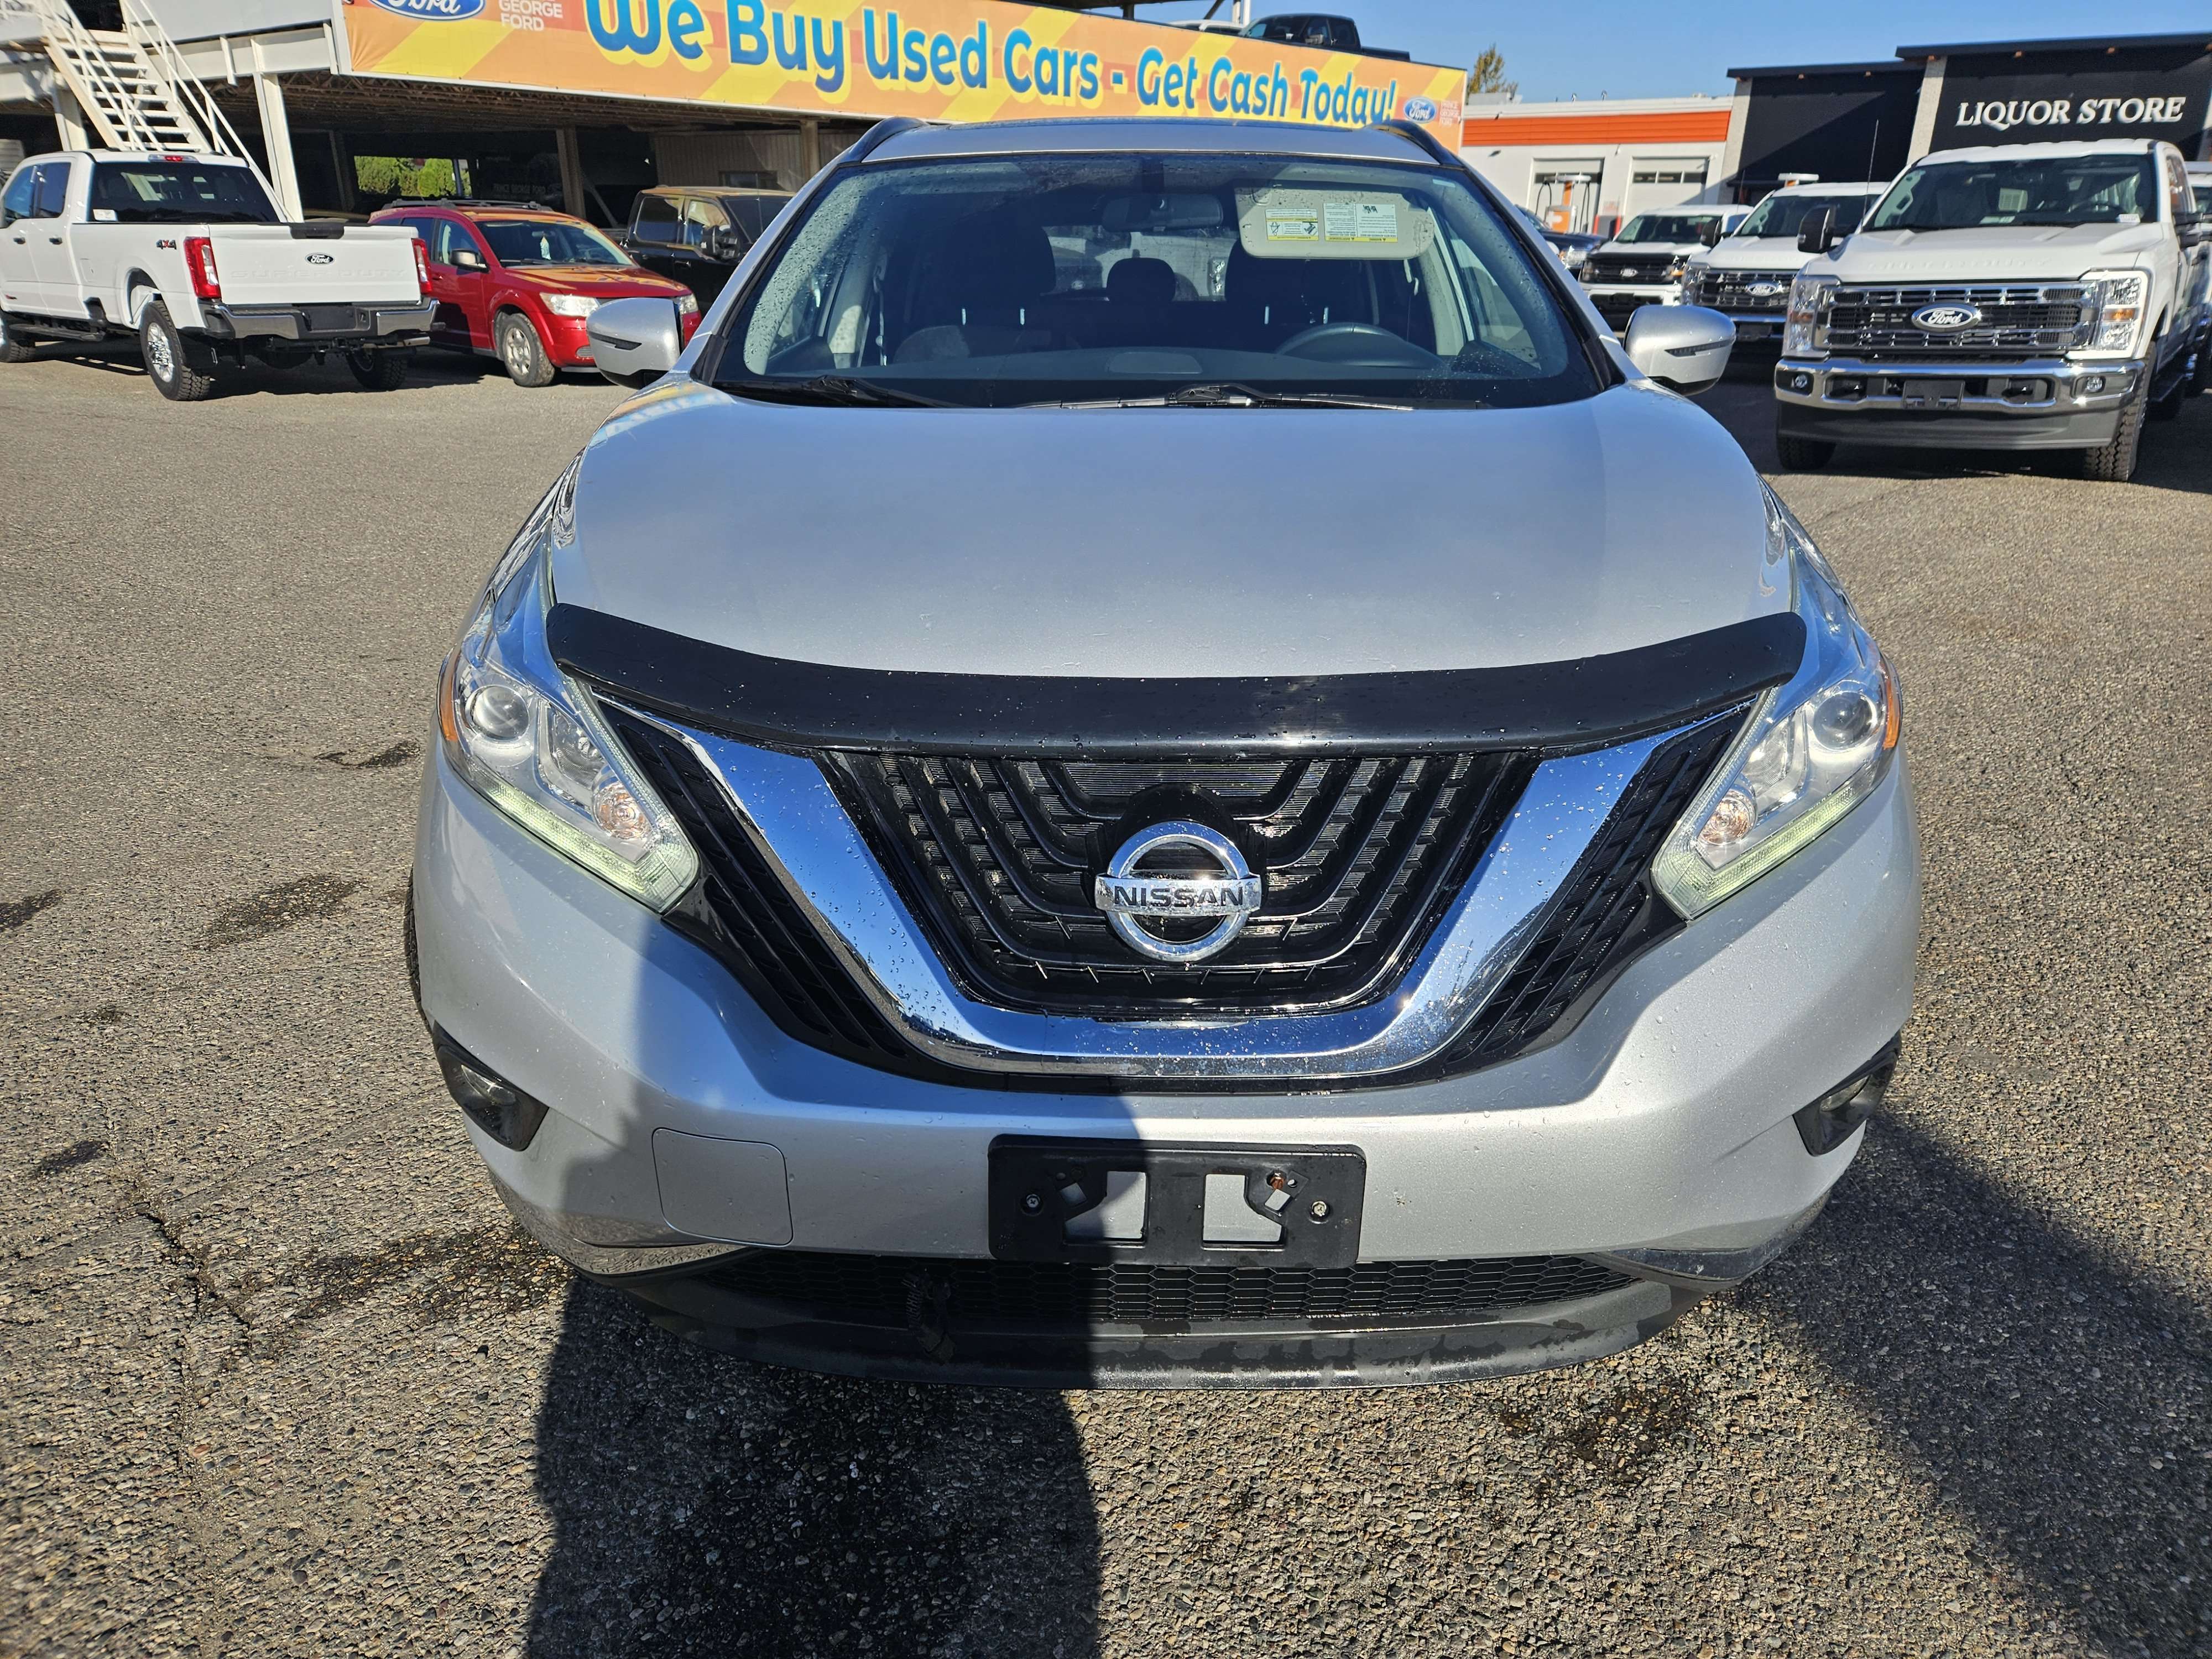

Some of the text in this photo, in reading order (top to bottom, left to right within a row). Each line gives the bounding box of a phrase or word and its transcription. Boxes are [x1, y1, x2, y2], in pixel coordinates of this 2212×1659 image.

[498, 0, 564, 18] GEORGE
[500, 12, 545, 31] FORD
[585, 0, 705, 60] We
[727, 0, 844, 93] Buy
[863, 8, 987, 89] Used
[1004, 28, 1099, 100] Cars
[1138, 46, 1198, 109] Get
[1209, 56, 1288, 117] Cash
[1300, 68, 1396, 124] Today!
[1955, 96, 2186, 131] LIQUOR STORE
[310, 254, 331, 264] Ford
[1927, 309, 1963, 325] Ford
[1113, 885, 1244, 907] NISSAN
